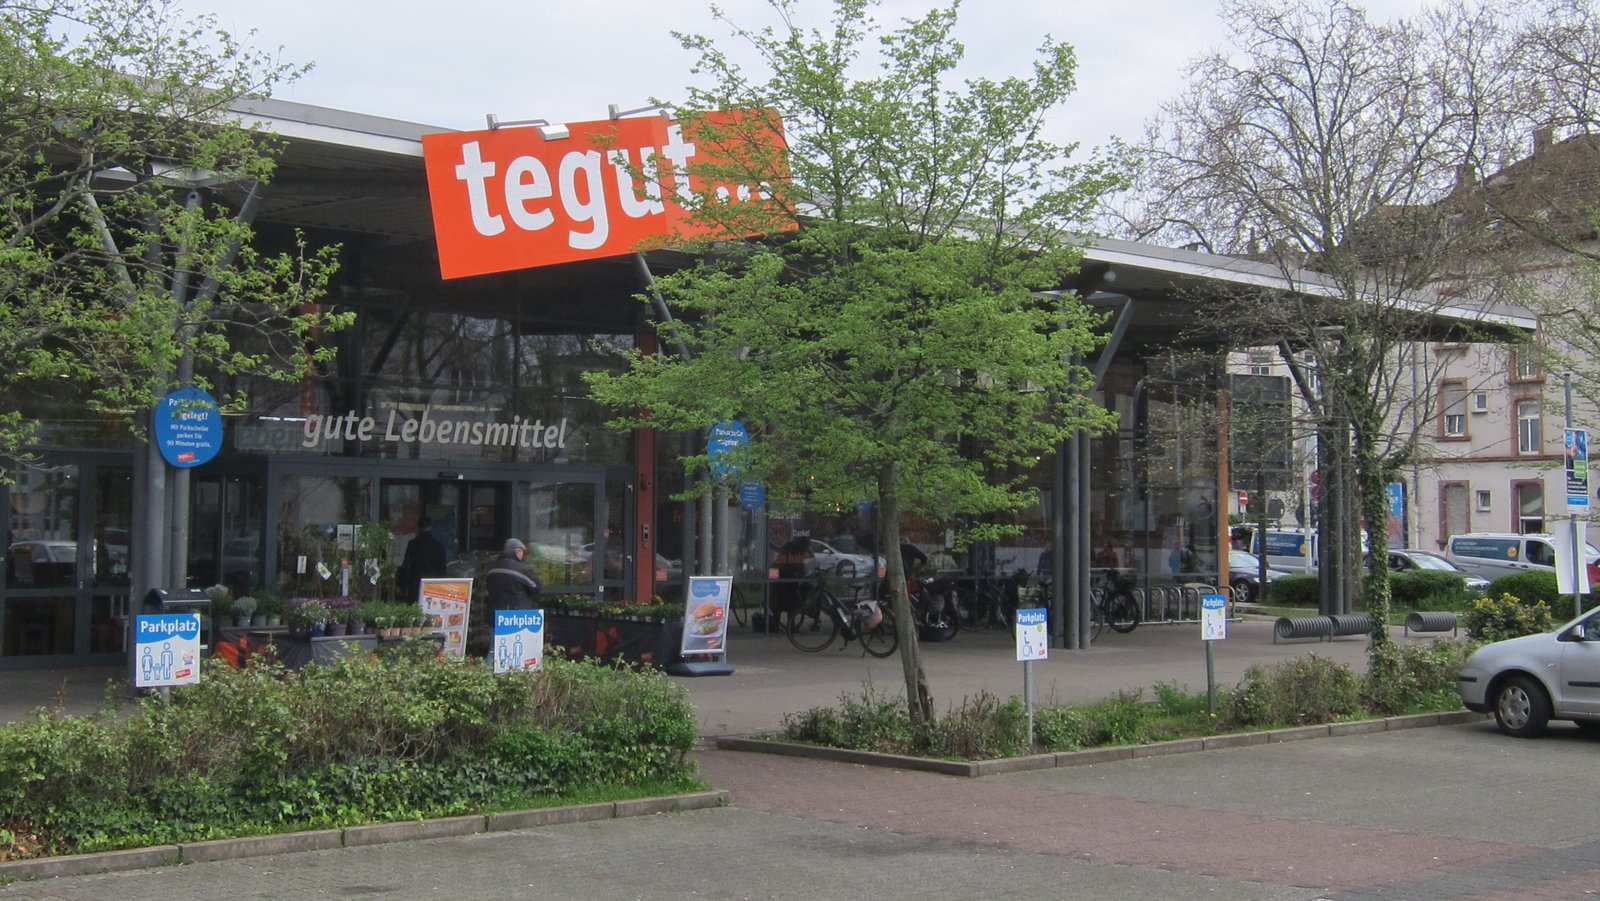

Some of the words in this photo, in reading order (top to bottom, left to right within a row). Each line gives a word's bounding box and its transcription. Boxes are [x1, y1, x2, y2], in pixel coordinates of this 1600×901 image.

[302, 410, 375, 448] gute
[384, 405, 567, 449] Lebensmittel
[1203, 598, 1224, 608] Parkplatz
[498, 614, 541, 628] Parkplatz
[1018, 612, 1045, 624] Parkplatz
[140, 619, 197, 635] Parkplatz
